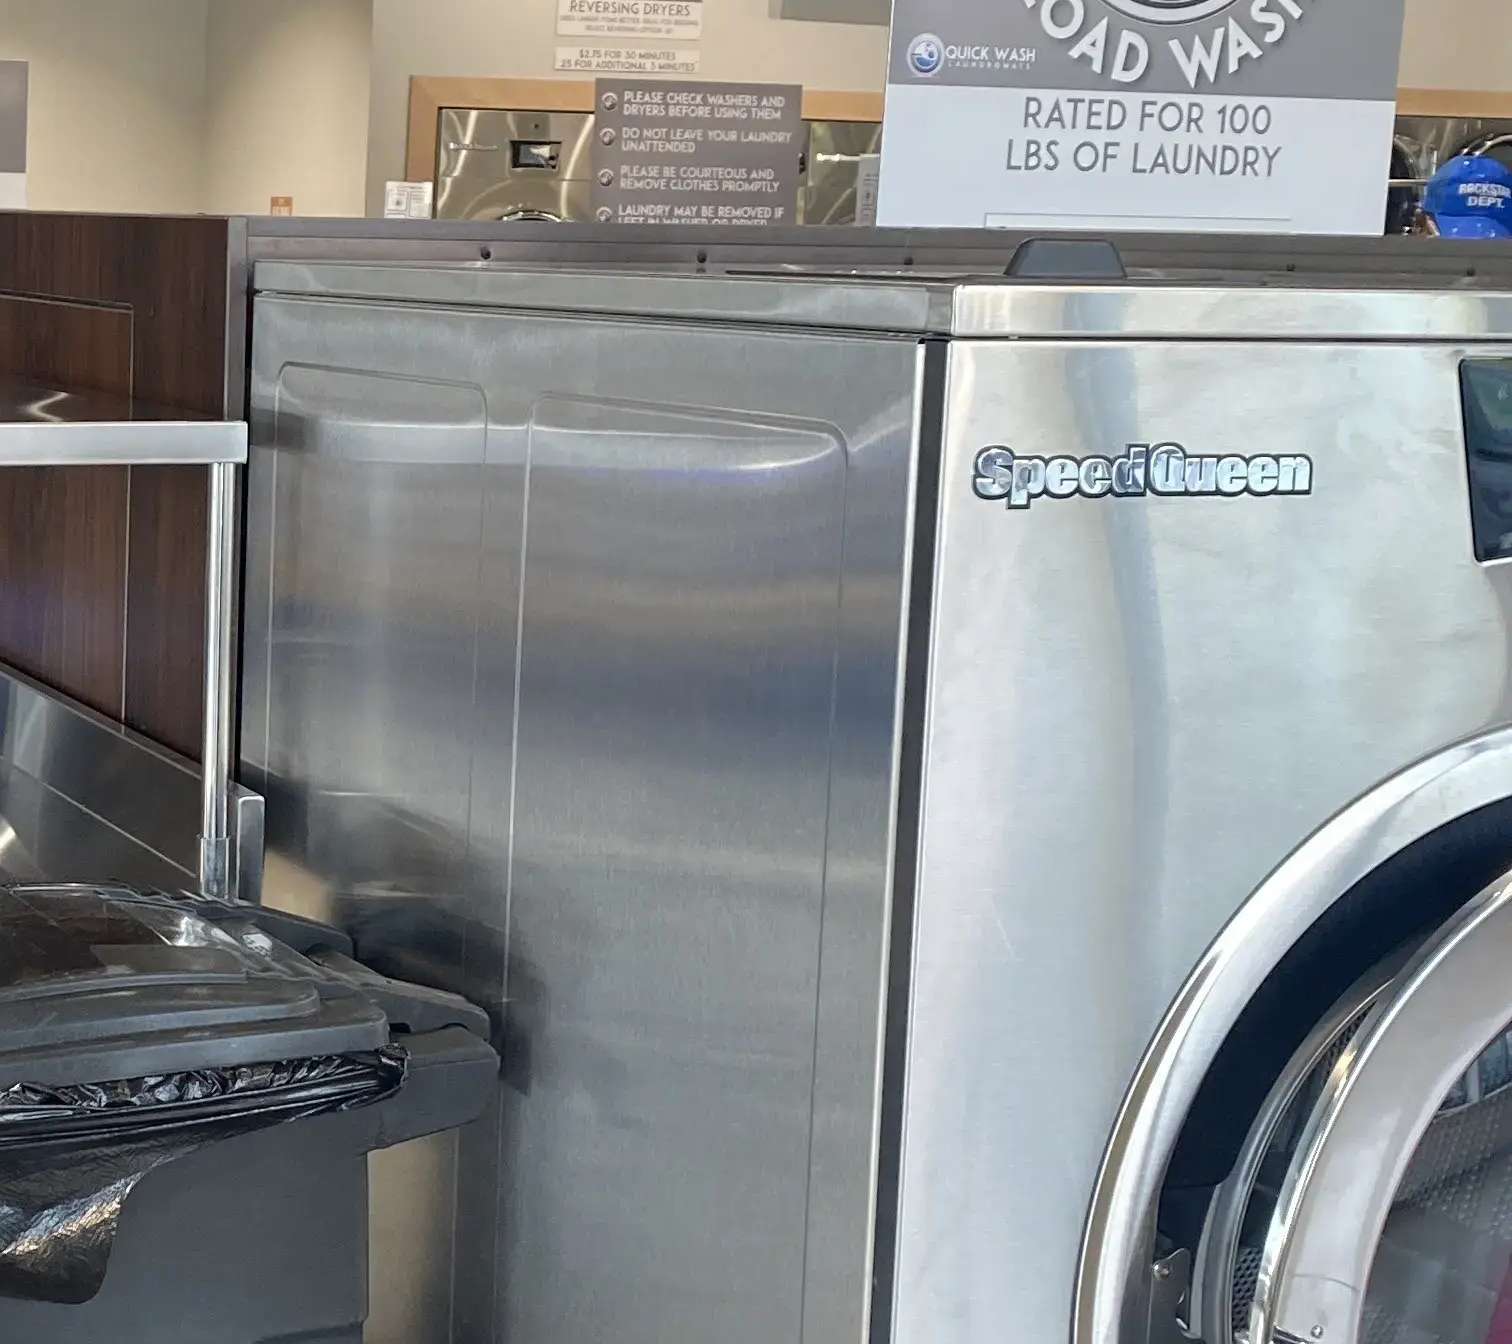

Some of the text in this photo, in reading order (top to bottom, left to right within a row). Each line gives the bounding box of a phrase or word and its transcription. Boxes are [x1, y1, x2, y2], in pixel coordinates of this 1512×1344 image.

[569, 0, 691, 16] REVERSING DRYERS
[604, 50, 622, 59] FOR
[625, 50, 636, 60] 30
[638, 51, 676, 61] MINUTES
[945, 45, 1036, 62] QUICK WASH
[575, 59, 592, 68] FOR
[595, 60, 647, 70] ADDITIONAL
[658, 62, 696, 72] MINUTES
[624, 90, 785, 107] PLEASE CHECK WASHERS AND
[623, 104, 781, 119] DRYERS BEFORE USING THEM
[1023, 96, 1272, 135] RATED FOR 100
[622, 127, 792, 143] DO NOT LEAVE YOUR LAUNDRY
[621, 141, 696, 153] UNATTENDED
[1006, 138, 1282, 177] LBS OF LAUNDRY
[620, 165, 774, 180] PLEASE BE COURTEOUS AND
[620, 178, 780, 193] REMOVE CLOTHES PROMPTLY
[618, 204, 785, 218] LAUNDRY MAY BE REMOVED IF
